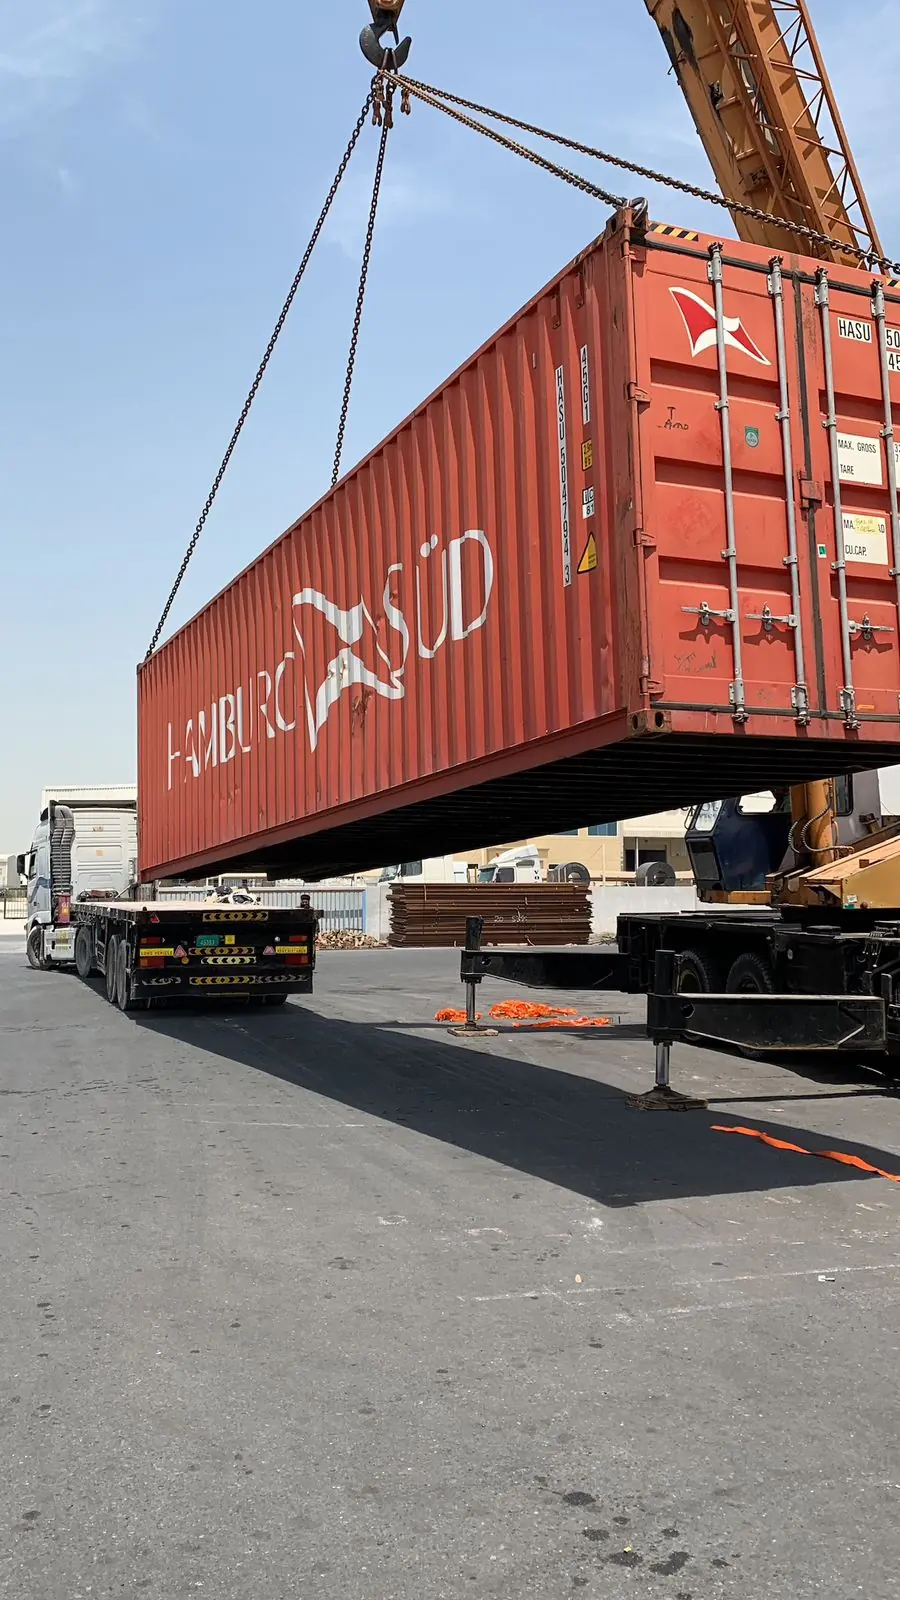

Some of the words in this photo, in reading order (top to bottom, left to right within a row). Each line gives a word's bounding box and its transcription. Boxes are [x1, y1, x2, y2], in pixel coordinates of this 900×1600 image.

[838, 319, 870, 341] HASU
[581, 347, 589, 421] 45G1
[857, 442, 877, 453] GROSS
[556, 367, 564, 440] HASU
[560, 446, 569, 556] 504794
[565, 565, 570, 583] 3
[840, 463, 855, 475] TARE
[845, 544, 867, 556] CU.CAP.
[383, 529, 494, 677] SÜD
